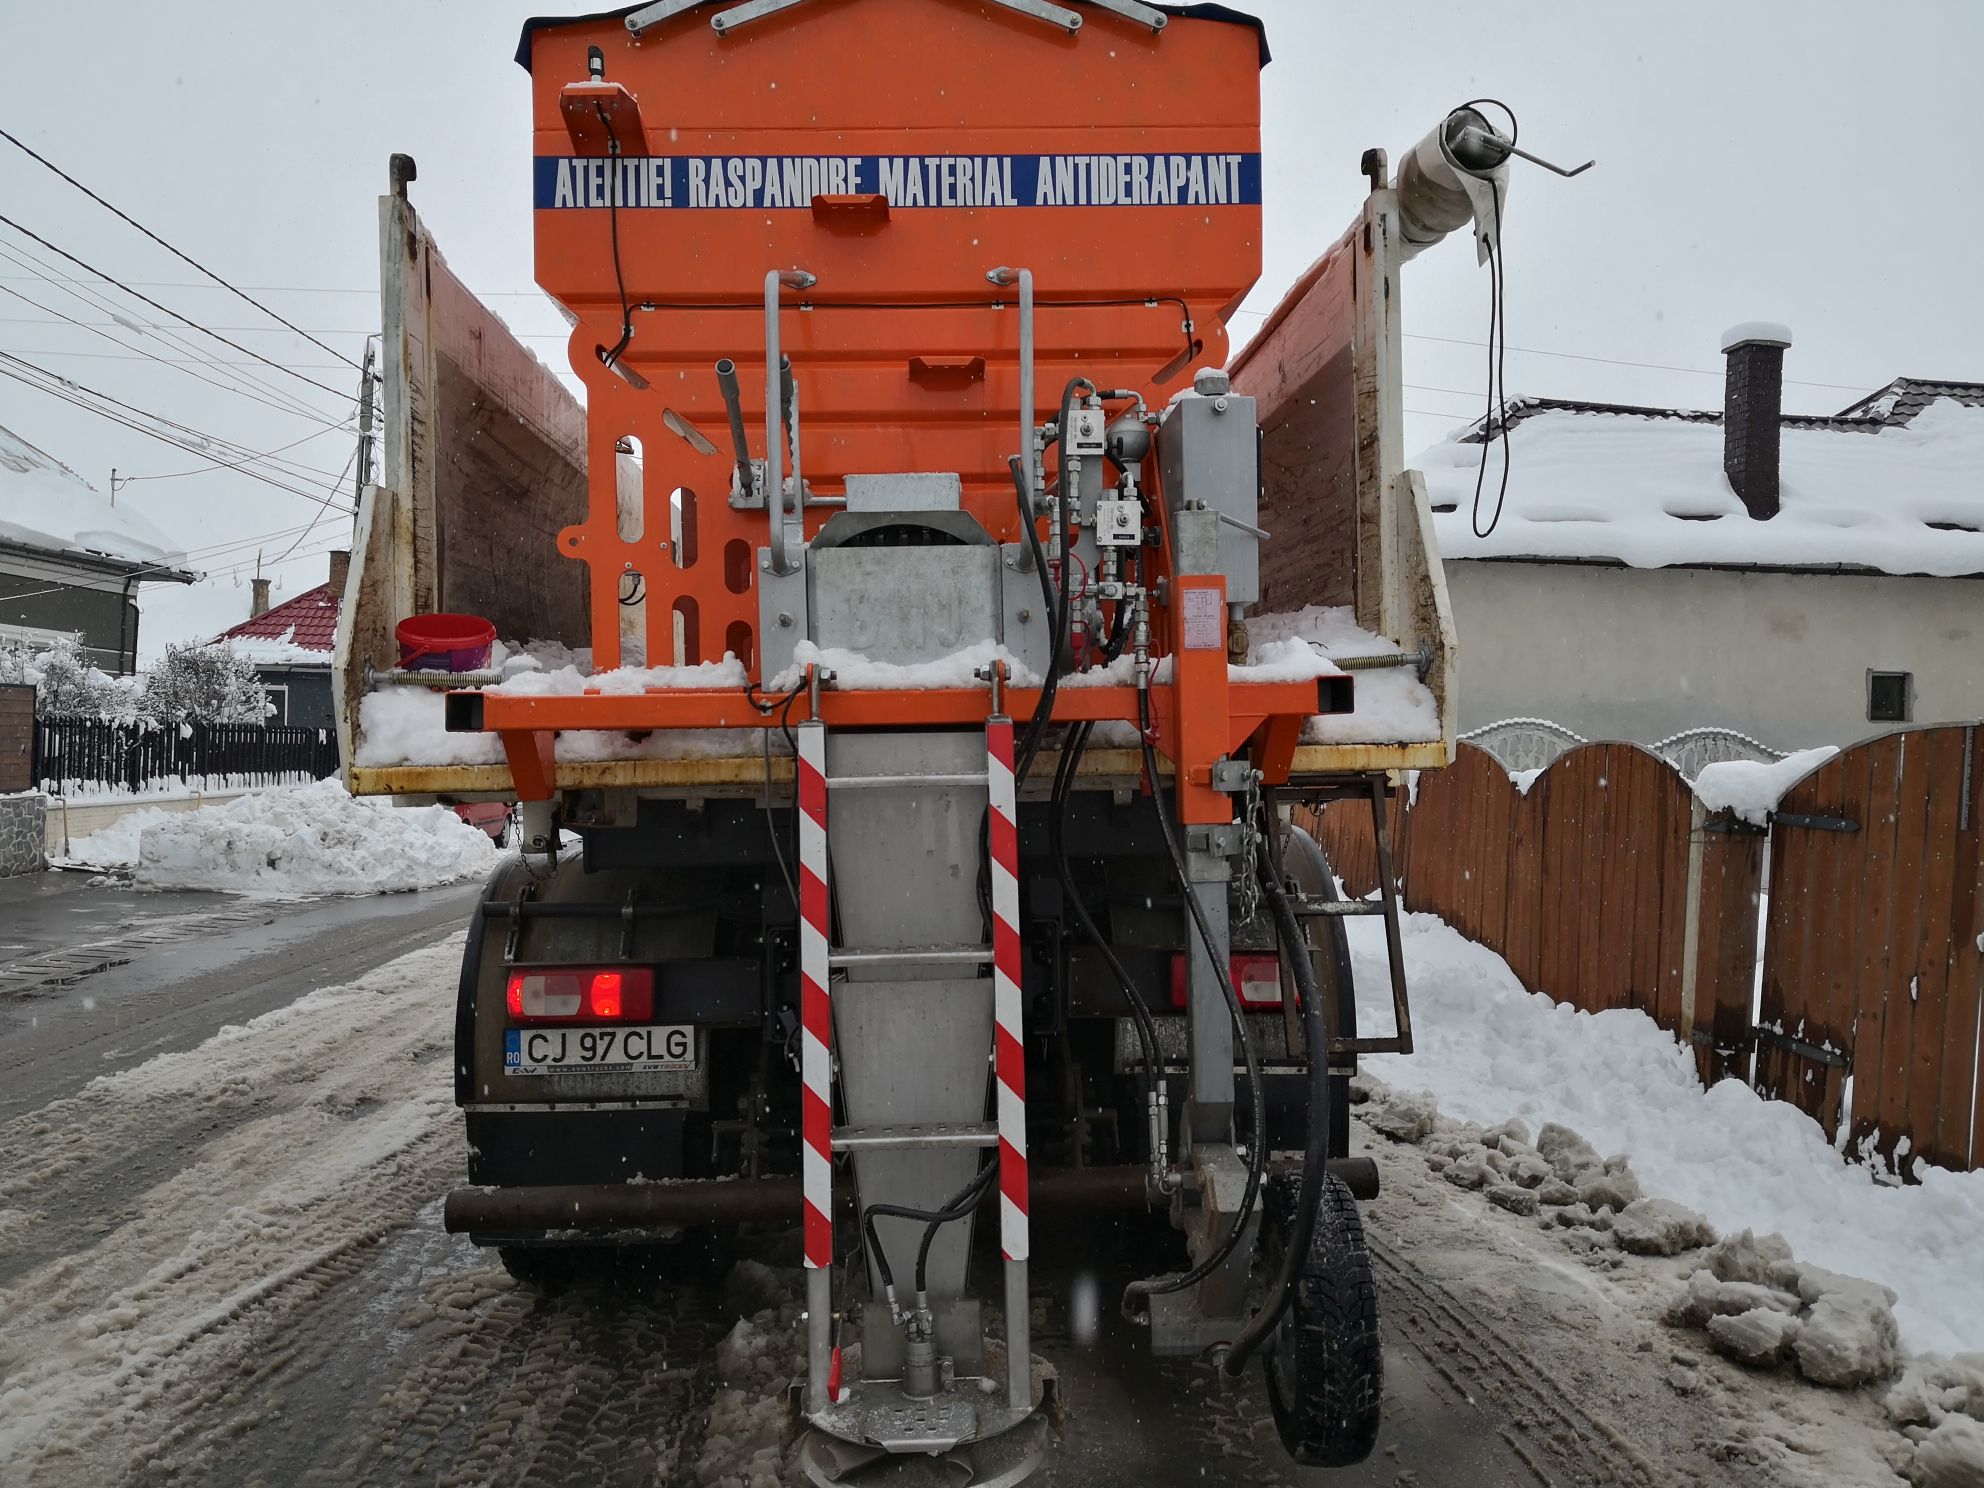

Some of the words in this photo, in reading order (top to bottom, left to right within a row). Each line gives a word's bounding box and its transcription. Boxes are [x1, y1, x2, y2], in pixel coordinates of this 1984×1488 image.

[554, 157, 673, 208] ATENTIE!
[688, 157, 862, 208] RASPANDIRE
[878, 156, 1018, 207] MATERIAL
[1035, 154, 1242, 206] ANTIDERAPANT
[755, 474, 761, 482] 2
[755, 487, 761, 496] 1
[506, 1051, 520, 1065] RO
[527, 1032, 567, 1064] CJ
[579, 1031, 617, 1062] 97
[623, 1029, 688, 1061] CLG
